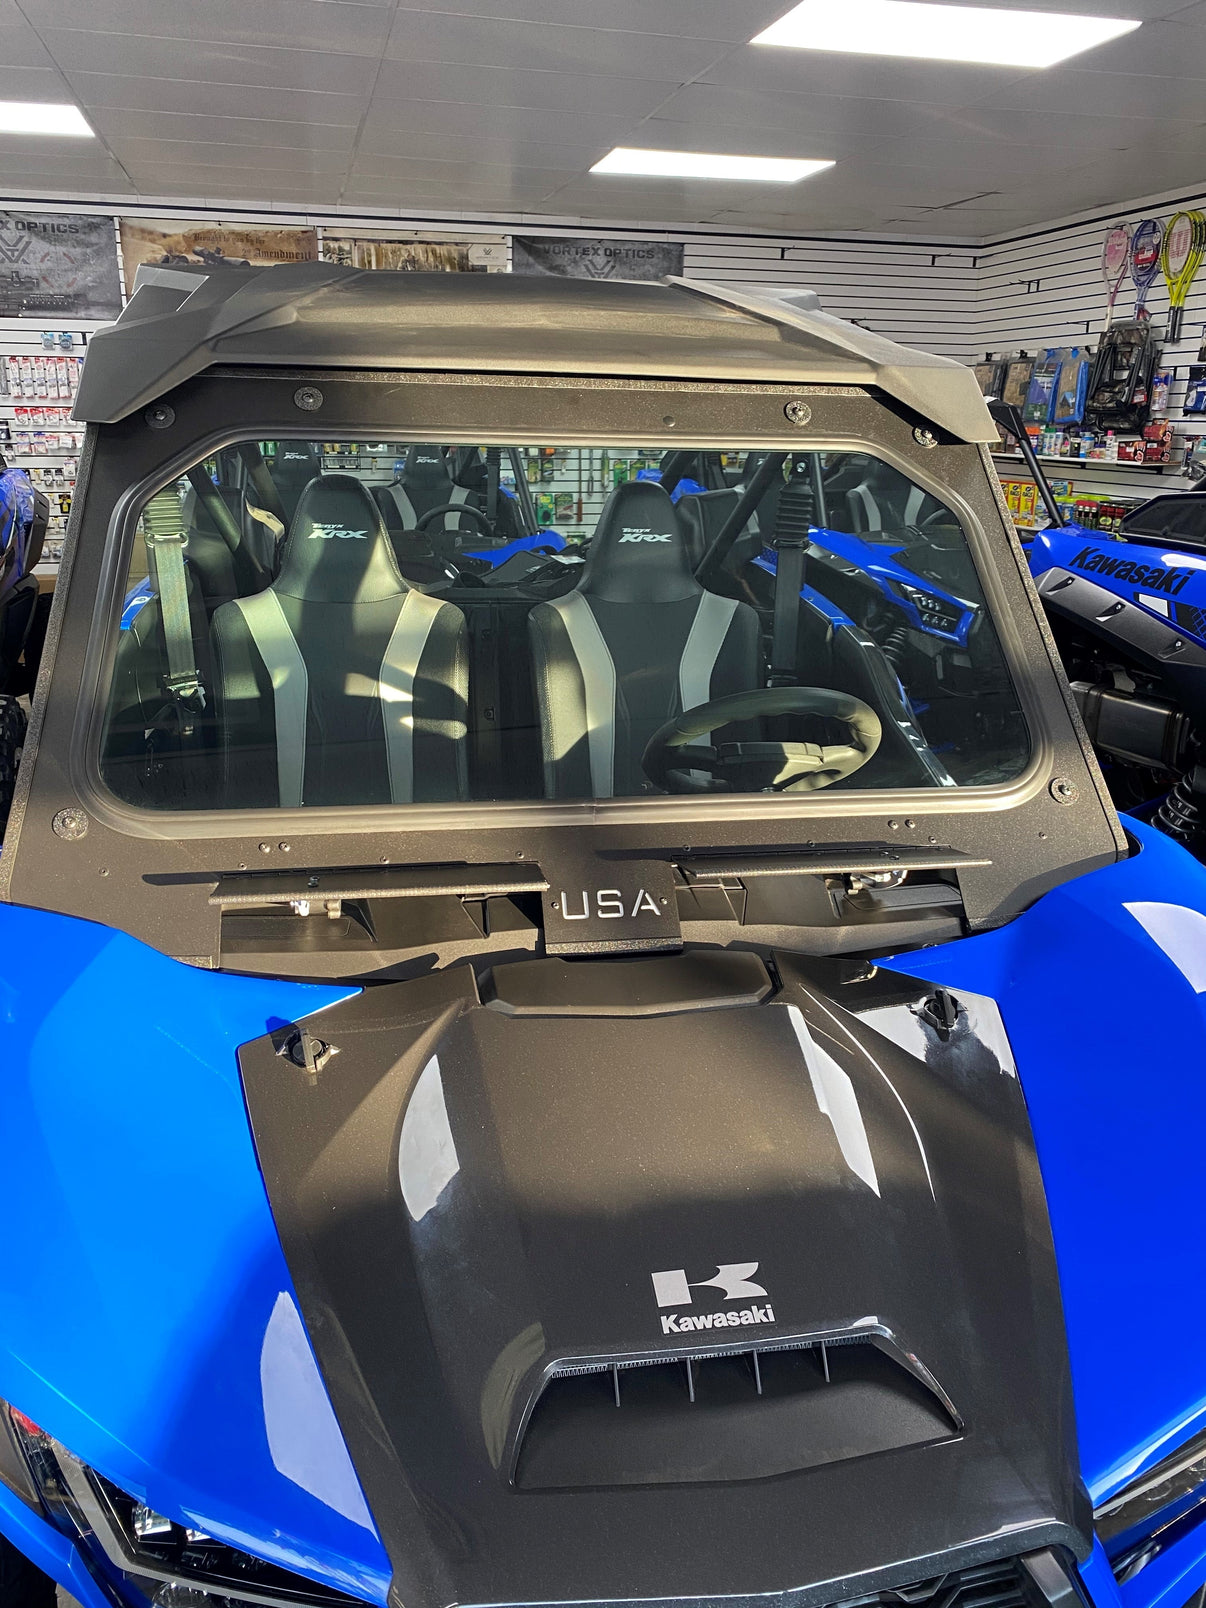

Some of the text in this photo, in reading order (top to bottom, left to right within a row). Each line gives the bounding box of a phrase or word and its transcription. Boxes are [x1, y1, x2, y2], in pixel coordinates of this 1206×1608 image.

[15, 220, 80, 234] OPTICS
[253, 247, 312, 260] Amendment
[543, 245, 655, 259] VORTEX OPTICS
[307, 528, 369, 539] KRX
[618, 533, 673, 543] KRX
[1068, 546, 1197, 596] Kawasaki
[560, 888, 662, 920] USA
[660, 1304, 776, 1335] Kawasaki
